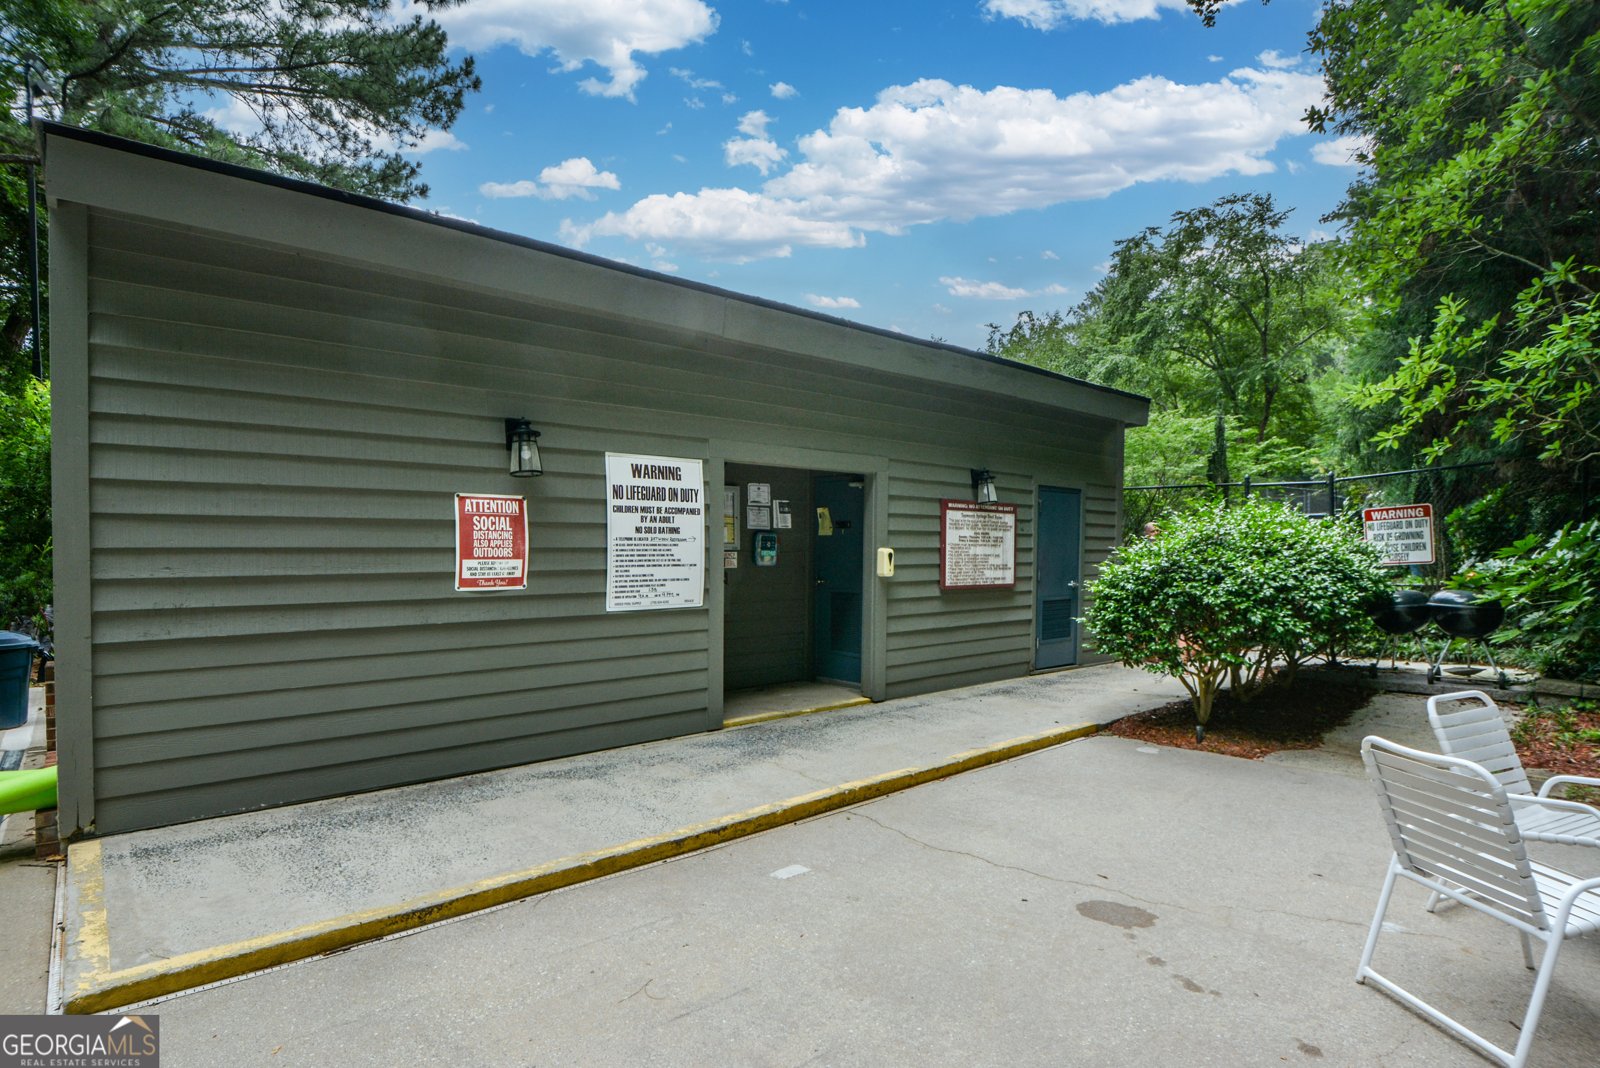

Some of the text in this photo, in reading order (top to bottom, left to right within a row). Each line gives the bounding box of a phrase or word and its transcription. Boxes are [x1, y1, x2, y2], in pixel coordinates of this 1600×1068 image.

[631, 464, 682, 481] WARNING
[612, 484, 699, 503] NO LIFEGUARD ON DUTY
[465, 499, 519, 514] ATTENTION
[613, 505, 638, 513] CHILDREN
[640, 506, 655, 514] MUST
[664, 507, 700, 515] ACCOMPANIED
[1371, 508, 1424, 520] WARNING
[473, 516, 512, 530] SOCIAL
[658, 516, 675, 524] ADULT
[1368, 519, 1428, 531] NO LIFEGUARD ON DUTY
[473, 530, 513, 540] DISTANCING
[635, 526, 642, 534] NO
[1394, 531, 1424, 541] DROWNING
[490, 540, 513, 548] APPLIES
[1401, 542, 1426, 551] CHILDREN
[473, 548, 513, 557] OUTDOORS
[495, 579, 508, 587] You!
